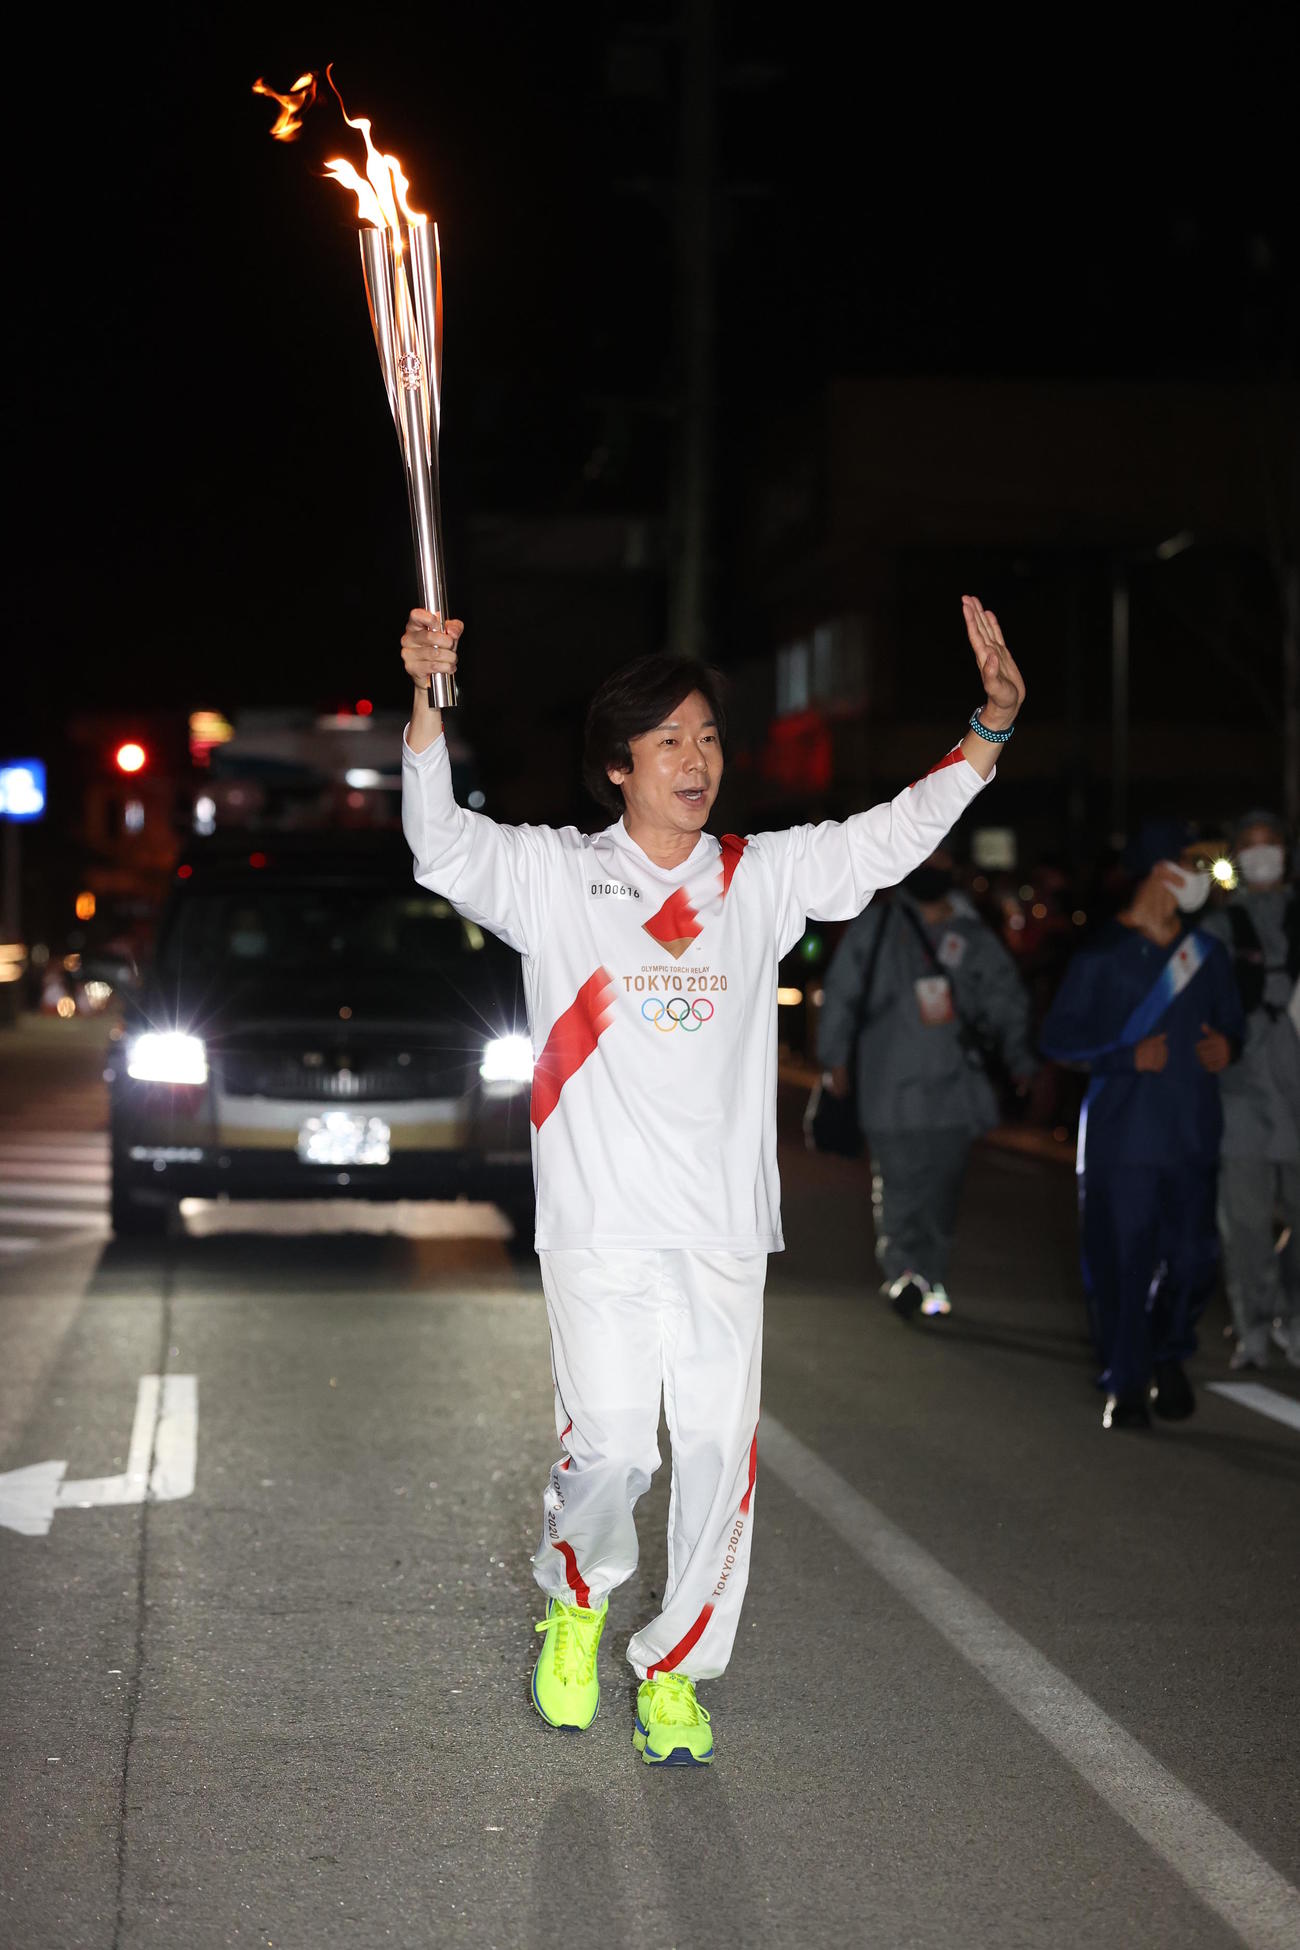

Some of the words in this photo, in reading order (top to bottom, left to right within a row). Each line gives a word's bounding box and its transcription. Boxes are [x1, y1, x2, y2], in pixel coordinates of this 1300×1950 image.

[591, 884, 640, 898] 0100616
[641, 965, 669, 973] OLYMPIC
[690, 966, 710, 974] RELAY
[623, 975, 683, 992] TOKYO
[686, 975, 728, 992] 2020
[553, 1474, 565, 1511] TOKYO
[548, 1510, 560, 1539] 2020
[712, 1554, 735, 1597] TOKYO
[728, 1520, 744, 1553] 2020
